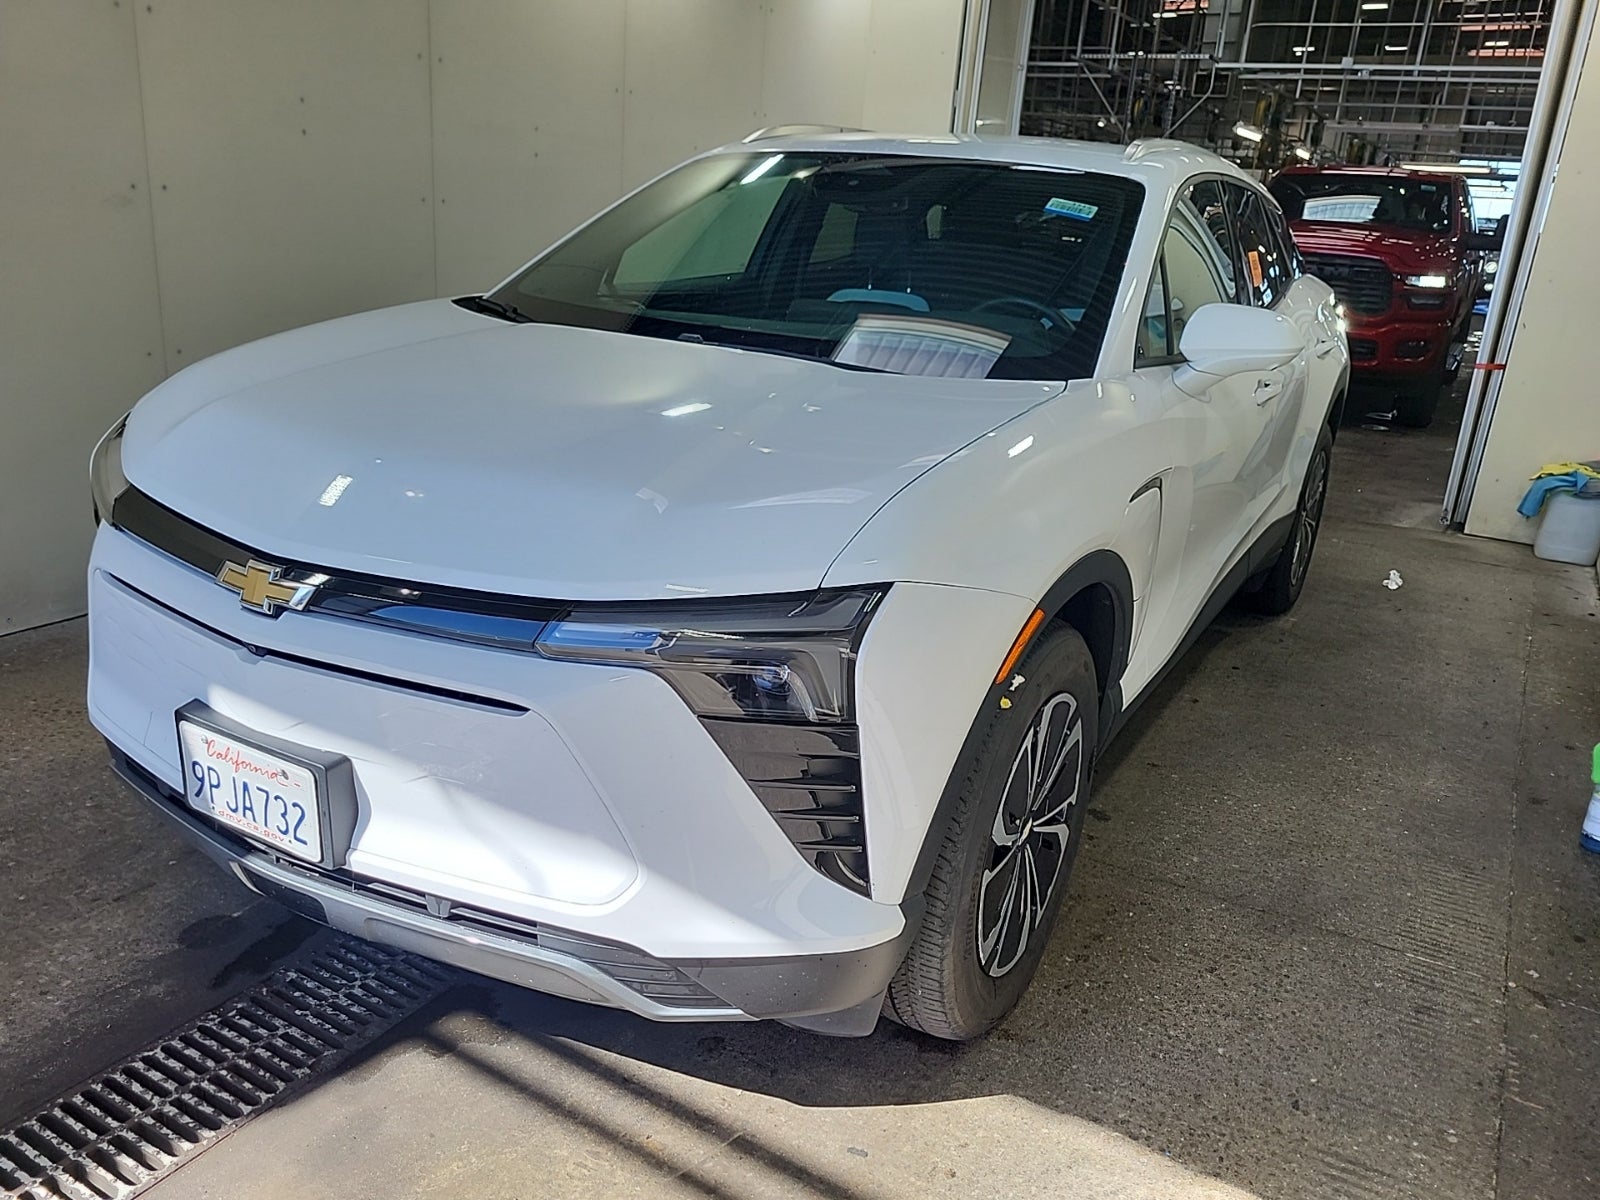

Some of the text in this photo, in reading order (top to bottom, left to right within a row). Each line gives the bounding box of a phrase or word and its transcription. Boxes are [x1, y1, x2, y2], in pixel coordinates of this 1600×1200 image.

[206, 739, 287, 786] California
[191, 760, 308, 846] 9PJA732
[218, 809, 285, 843] dmv.ca.gov
